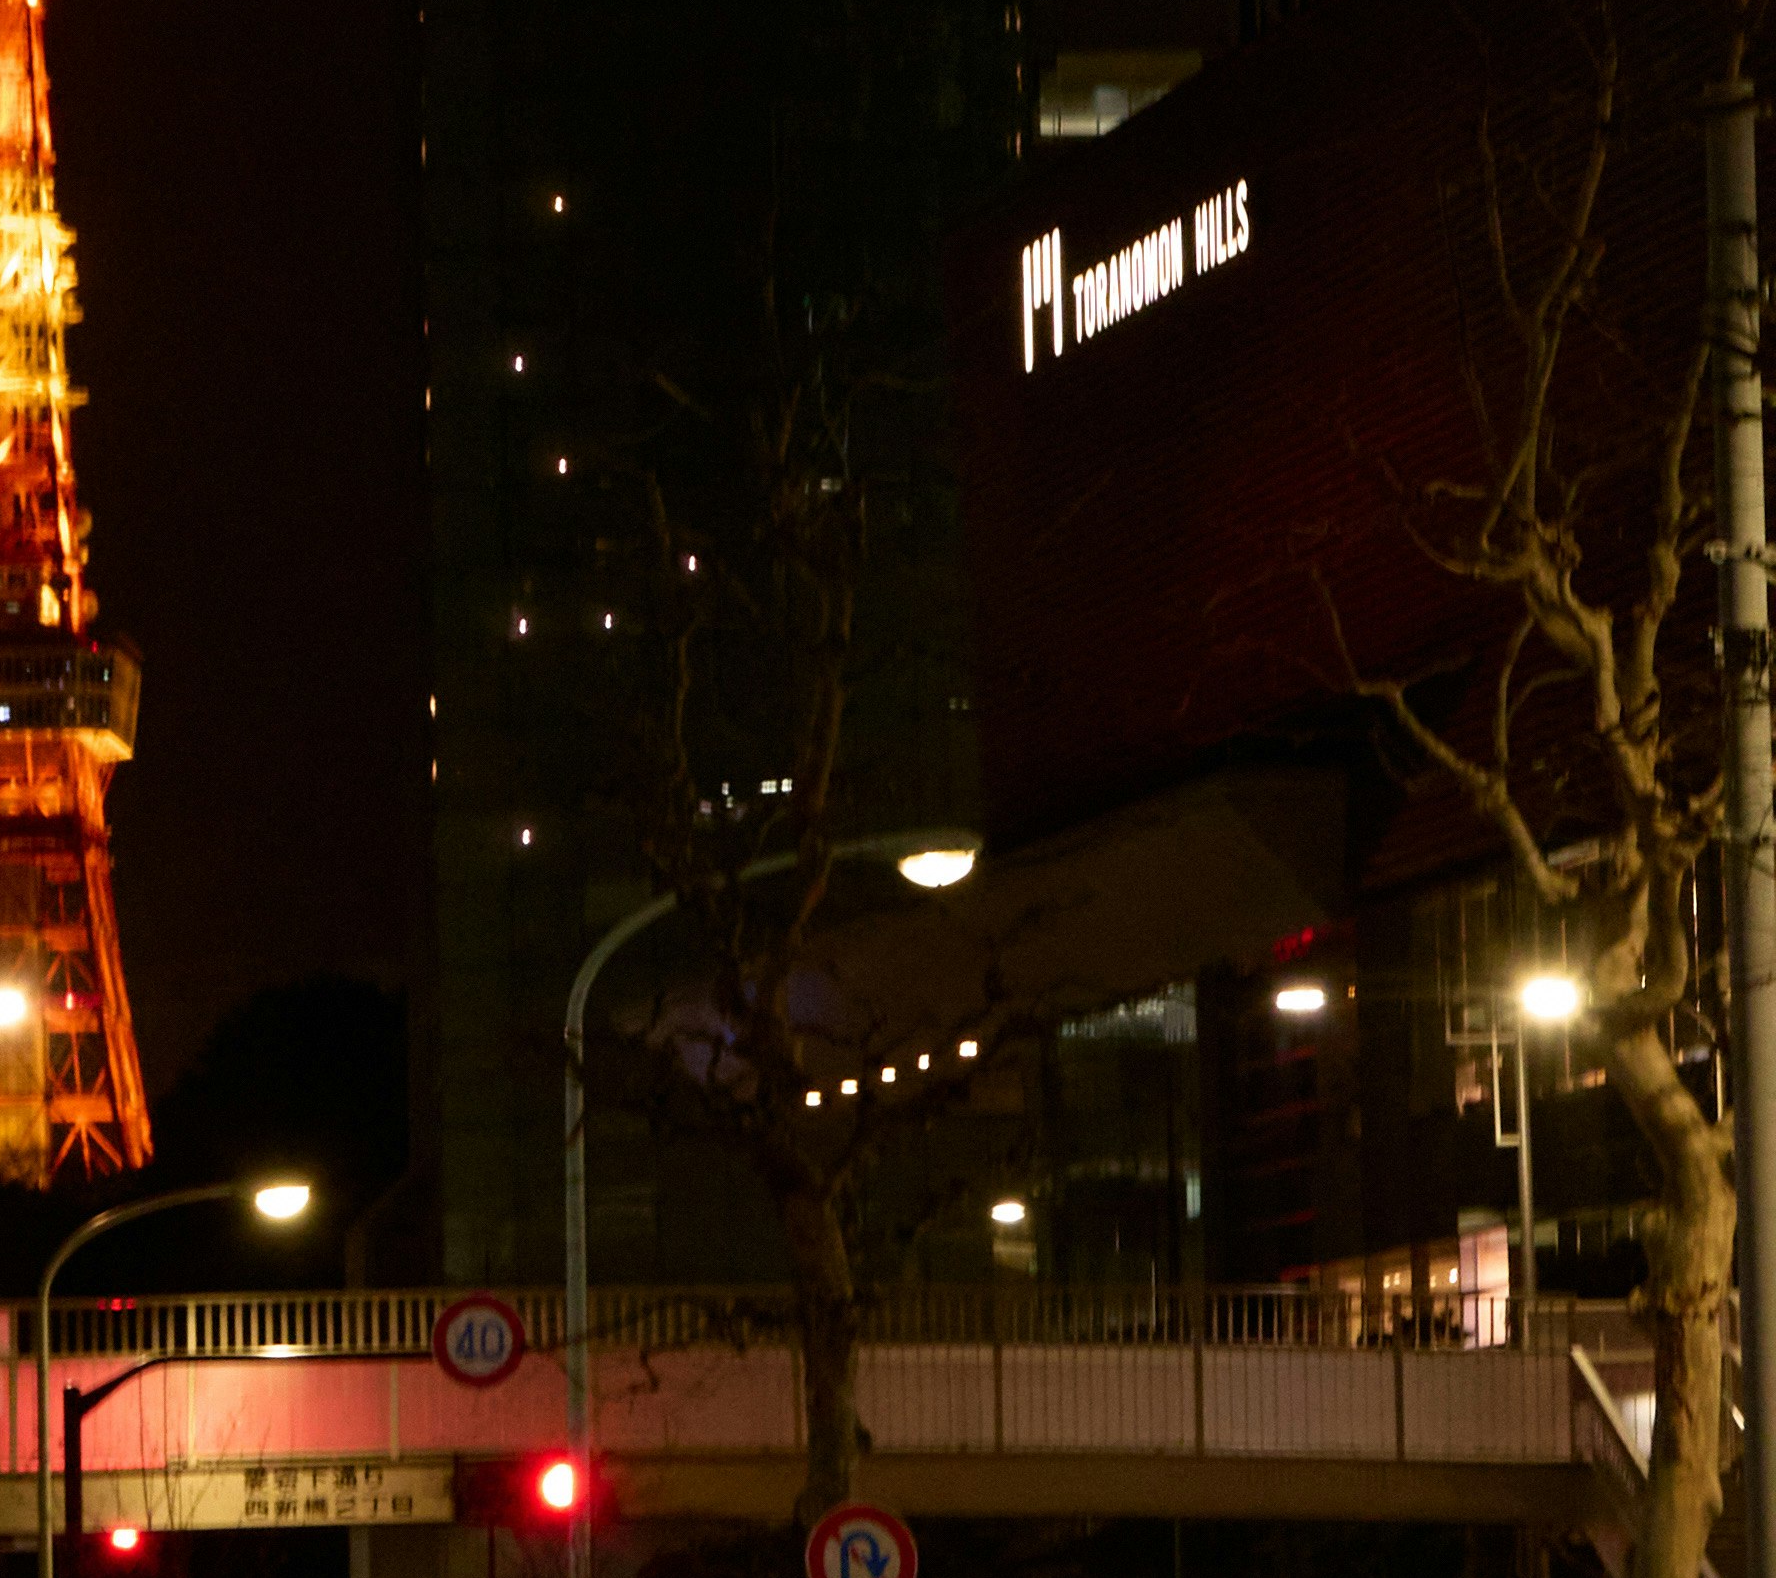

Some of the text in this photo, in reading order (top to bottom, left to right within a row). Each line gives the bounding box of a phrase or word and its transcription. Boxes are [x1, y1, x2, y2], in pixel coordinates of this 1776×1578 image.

[1072, 216, 1183, 345] TORANOMON
[1194, 178, 1250, 277] HILLS
[456, 1317, 505, 1361] 40
